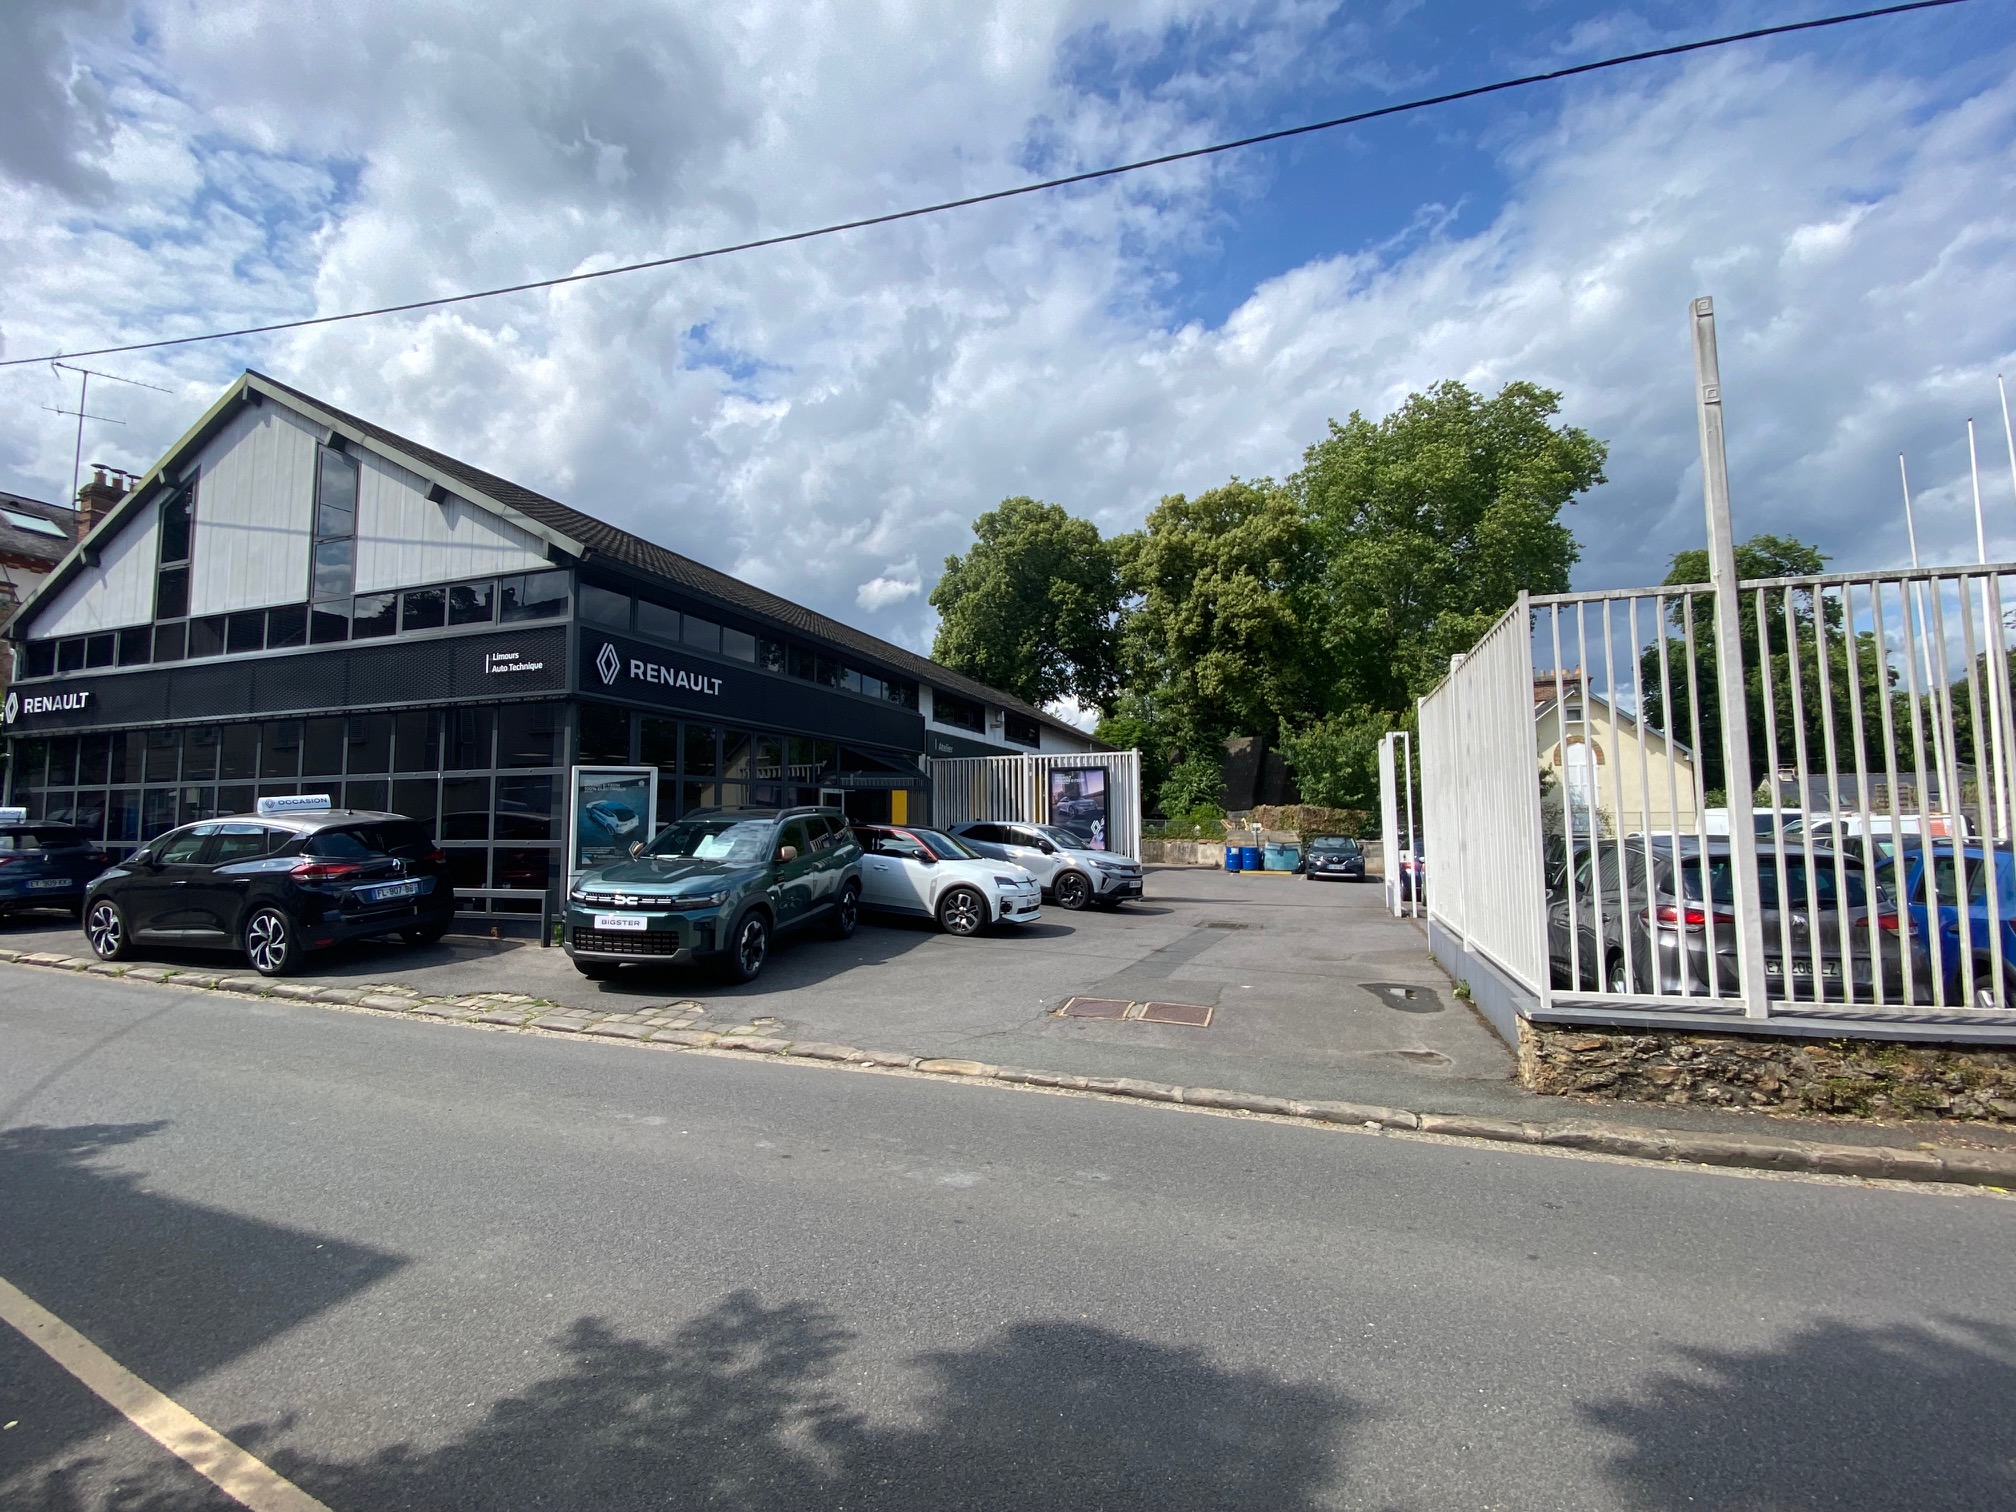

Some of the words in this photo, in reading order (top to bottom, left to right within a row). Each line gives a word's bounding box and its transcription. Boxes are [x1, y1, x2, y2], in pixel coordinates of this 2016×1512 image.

[492, 652, 520, 661] Limours
[491, 664, 508, 673] Auto
[508, 662, 543, 672] Technique
[630, 659, 723, 696] RENAULT
[24, 692, 89, 713] RENAULT
[938, 742, 953, 753] Atelier
[277, 797, 328, 806] OCCASION
